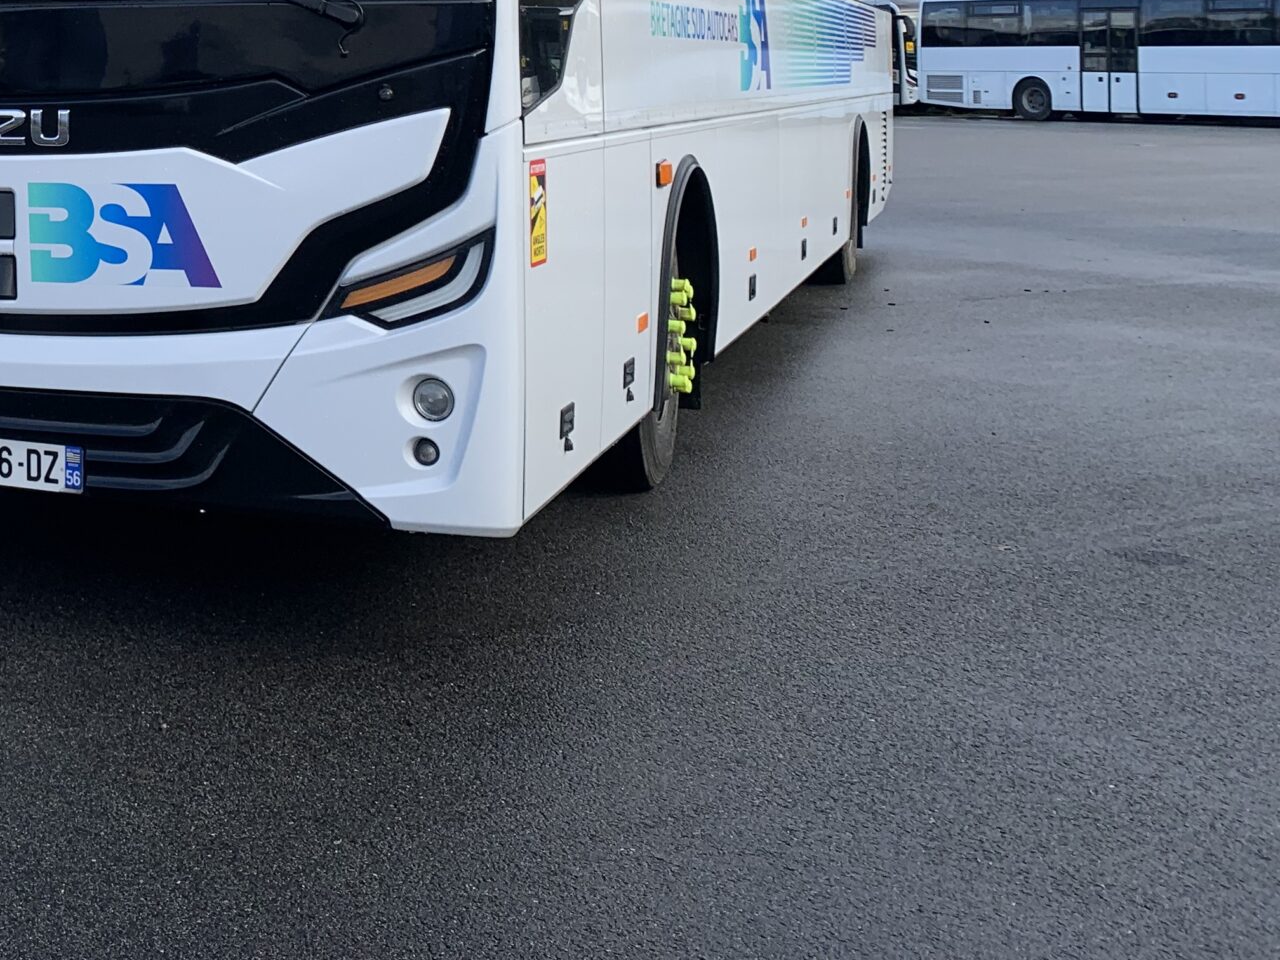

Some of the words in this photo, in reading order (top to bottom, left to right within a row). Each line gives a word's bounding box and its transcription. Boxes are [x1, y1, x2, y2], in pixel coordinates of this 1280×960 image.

[650, 0, 691, 39] BRETAGNE
[691, 6, 706, 41] SUD
[706, 9, 738, 43] AUTOCARS
[27, 182, 223, 288] BSA
[66, 469, 81, 487] 56
